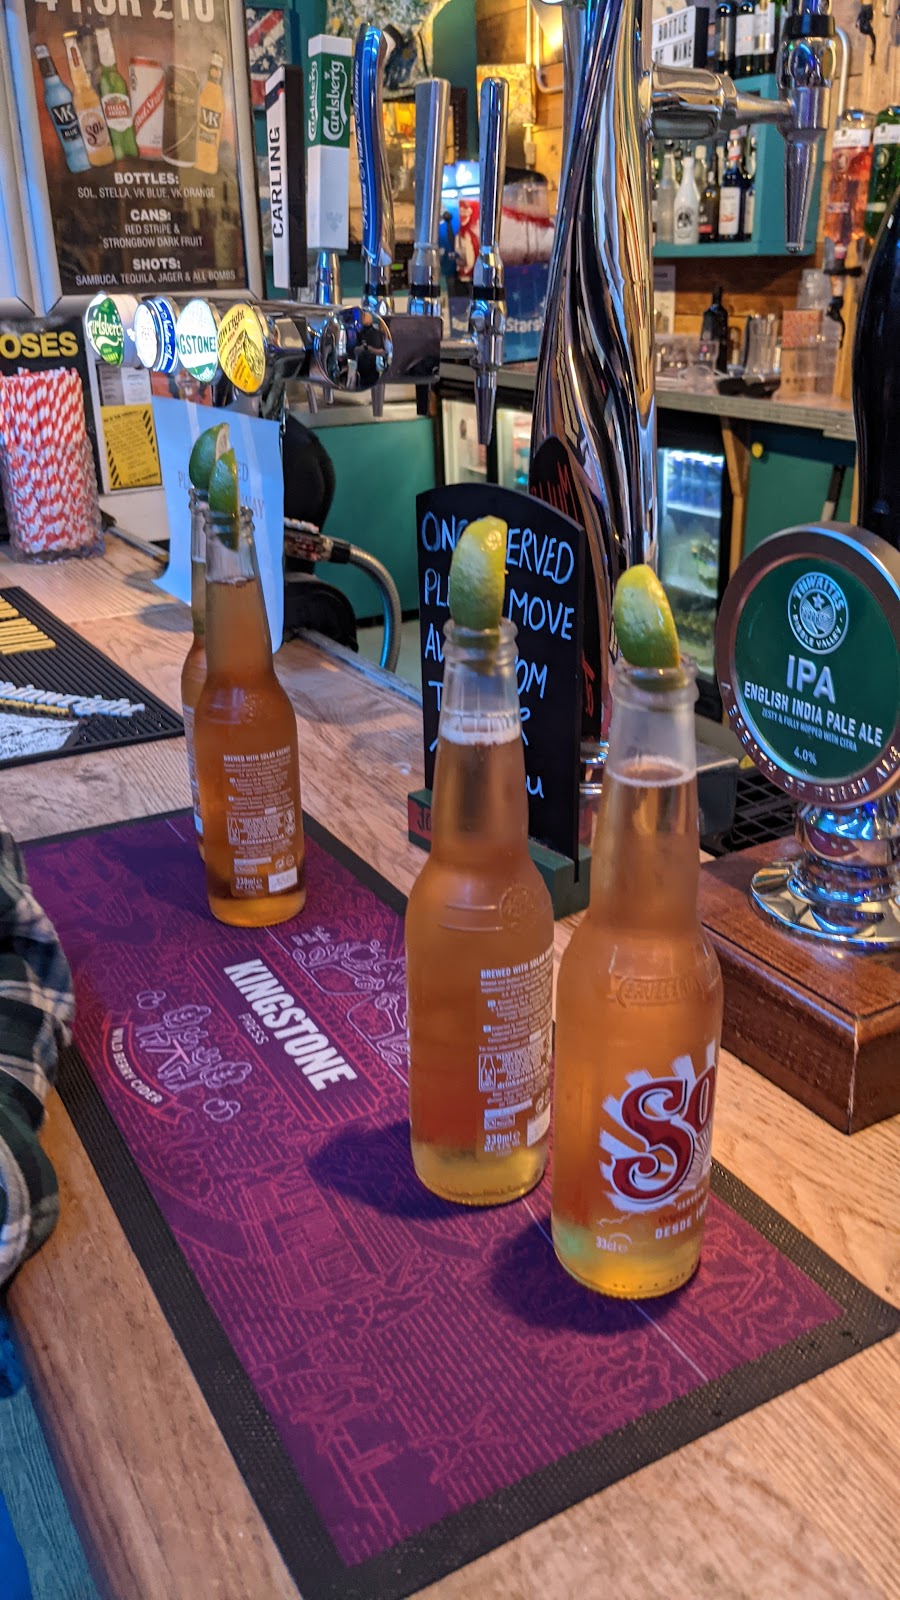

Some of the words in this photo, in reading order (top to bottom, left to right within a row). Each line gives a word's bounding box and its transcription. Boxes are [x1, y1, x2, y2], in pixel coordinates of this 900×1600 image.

[658, 14, 688, 42] BOTTLE
[322, 60, 348, 141] Carlsberg
[114, 172, 179, 185] BOTTLES:
[269, 126, 284, 238] CARLING
[133, 188, 145, 198] VK
[171, 188, 182, 198] VK
[183, 188, 215, 198] ORANGE
[130, 209, 172, 221] CANS:
[103, 237, 155, 249] STRONGBOW
[157, 236, 179, 248] DARK
[181, 236, 203, 247] FRUIT
[125, 224, 142, 235] RED
[144, 224, 171, 234] STRIPE
[174, 224, 180, 234] &
[133, 258, 182, 270] SHOTS:
[158, 272, 184, 283] JAGER
[185, 272, 191, 282] &
[193, 271, 206, 282] ALL
[207, 270, 235, 281] BOMBS
[0, 331, 79, 359] OSES
[176, 333, 217, 355] NGSTONE
[506, 527, 575, 585] ERVED
[792, 575, 845, 611] THWAITES
[508, 588, 575, 641] MOVE
[816, 625, 842, 648] VALLEY
[786, 654, 836, 704] IPA
[744, 681, 789, 713] ENGLISH
[792, 698, 823, 726] INDIA
[826, 709, 857, 738] PALE
[858, 722, 883, 748] ALE
[761, 706, 778, 721] ZESTY
[778, 713, 783, 724] &
[784, 715, 801, 731] FULLY
[800, 721, 823, 740] HOPPED
[823, 730, 839, 747] WITH
[840, 736, 858, 753] CITRA
[793, 745, 818, 767] 4.0%
[480, 966, 511, 979] BREWED
[512, 961, 529, 975] WITH
[223, 958, 358, 1091] KINGSTONE
[239, 1012, 269, 1045] PRESS
[112, 1027, 124, 1053] WILD
[112, 1050, 138, 1080] BERRY
[130, 1079, 163, 1105] CIDER
[655, 1215, 692, 1240] DESDE
